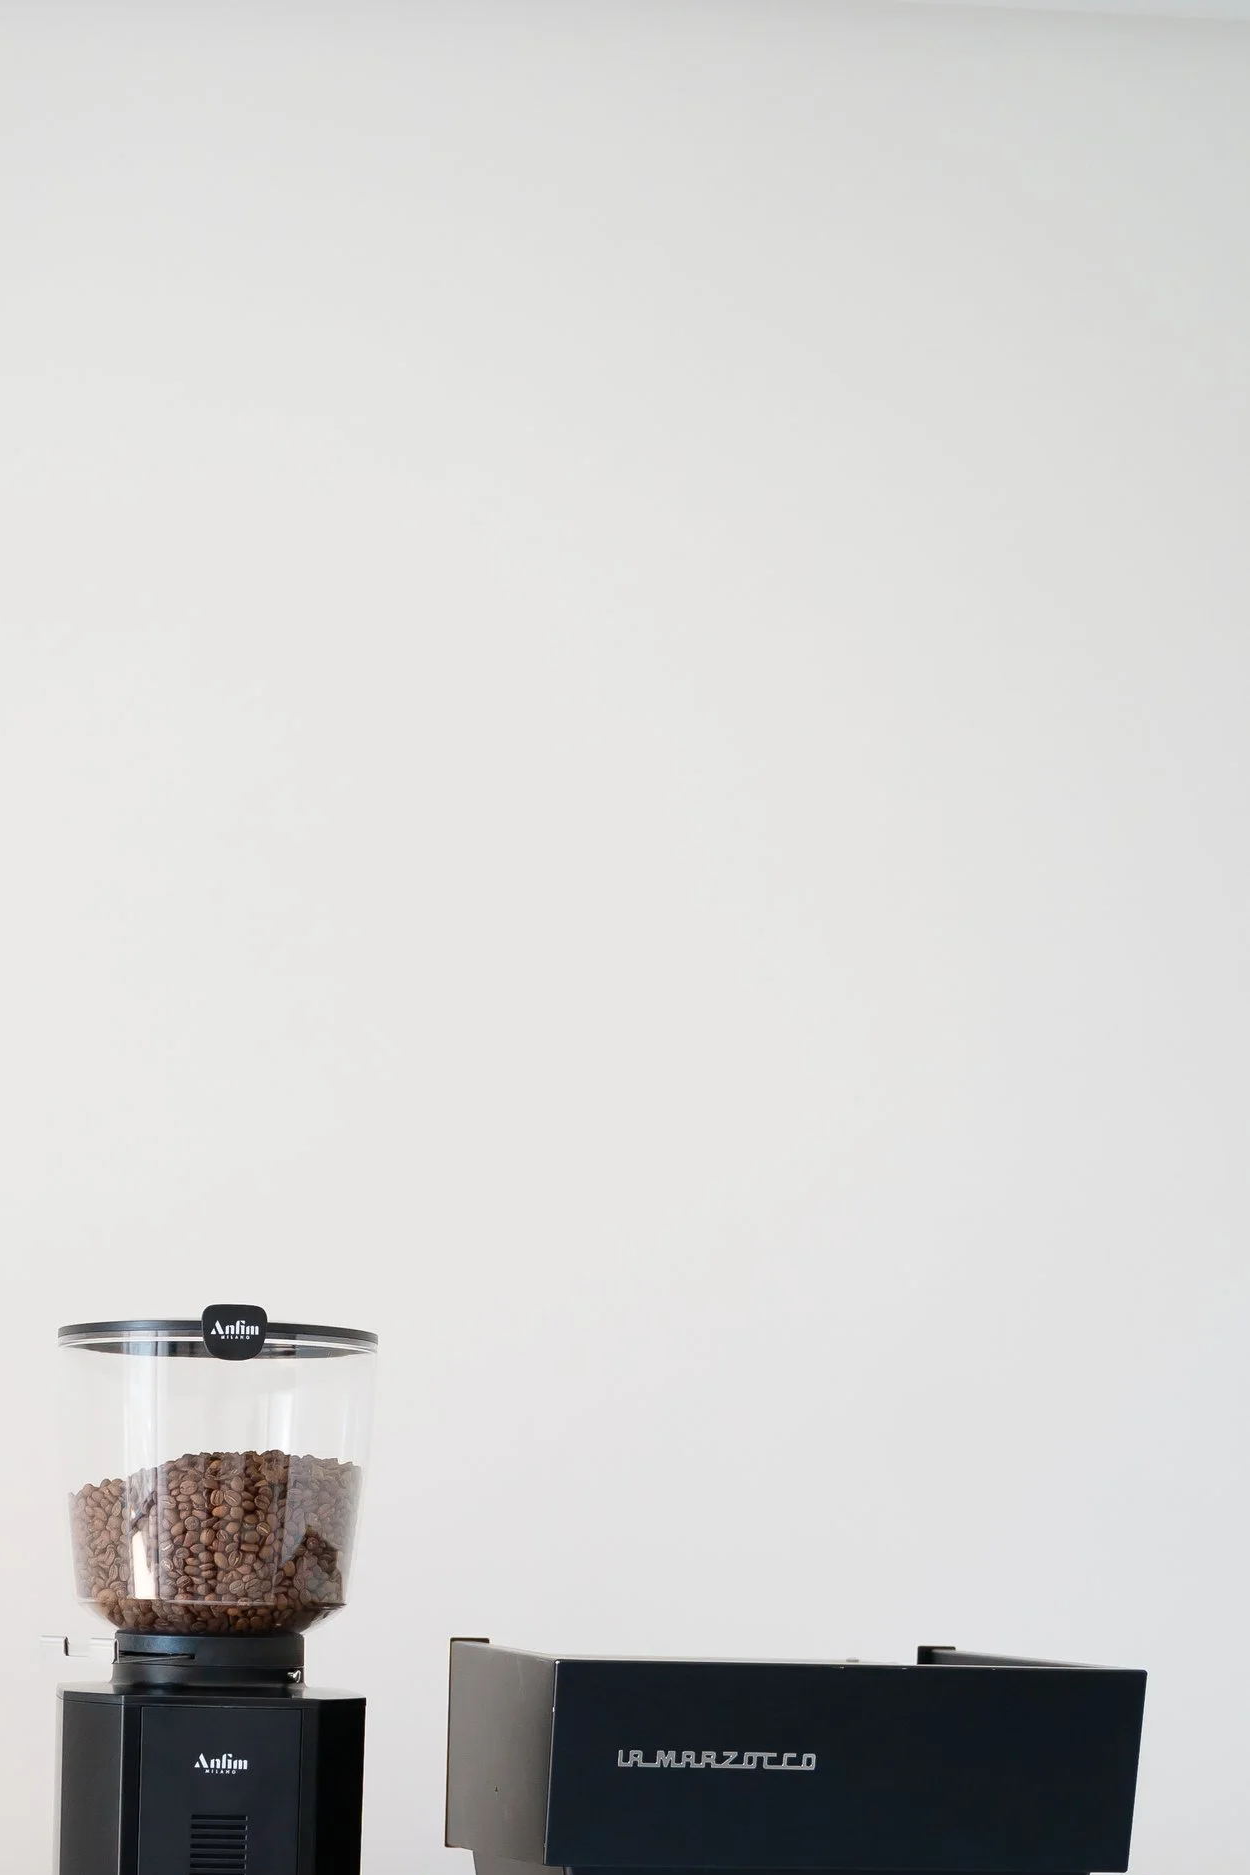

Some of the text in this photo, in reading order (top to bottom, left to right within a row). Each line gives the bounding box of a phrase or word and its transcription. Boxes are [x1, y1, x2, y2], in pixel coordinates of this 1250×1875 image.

[210, 1320, 259, 1335] Anfim
[194, 1753, 248, 1770] Anfim
[618, 1750, 816, 1770] LA MARZOCCO
